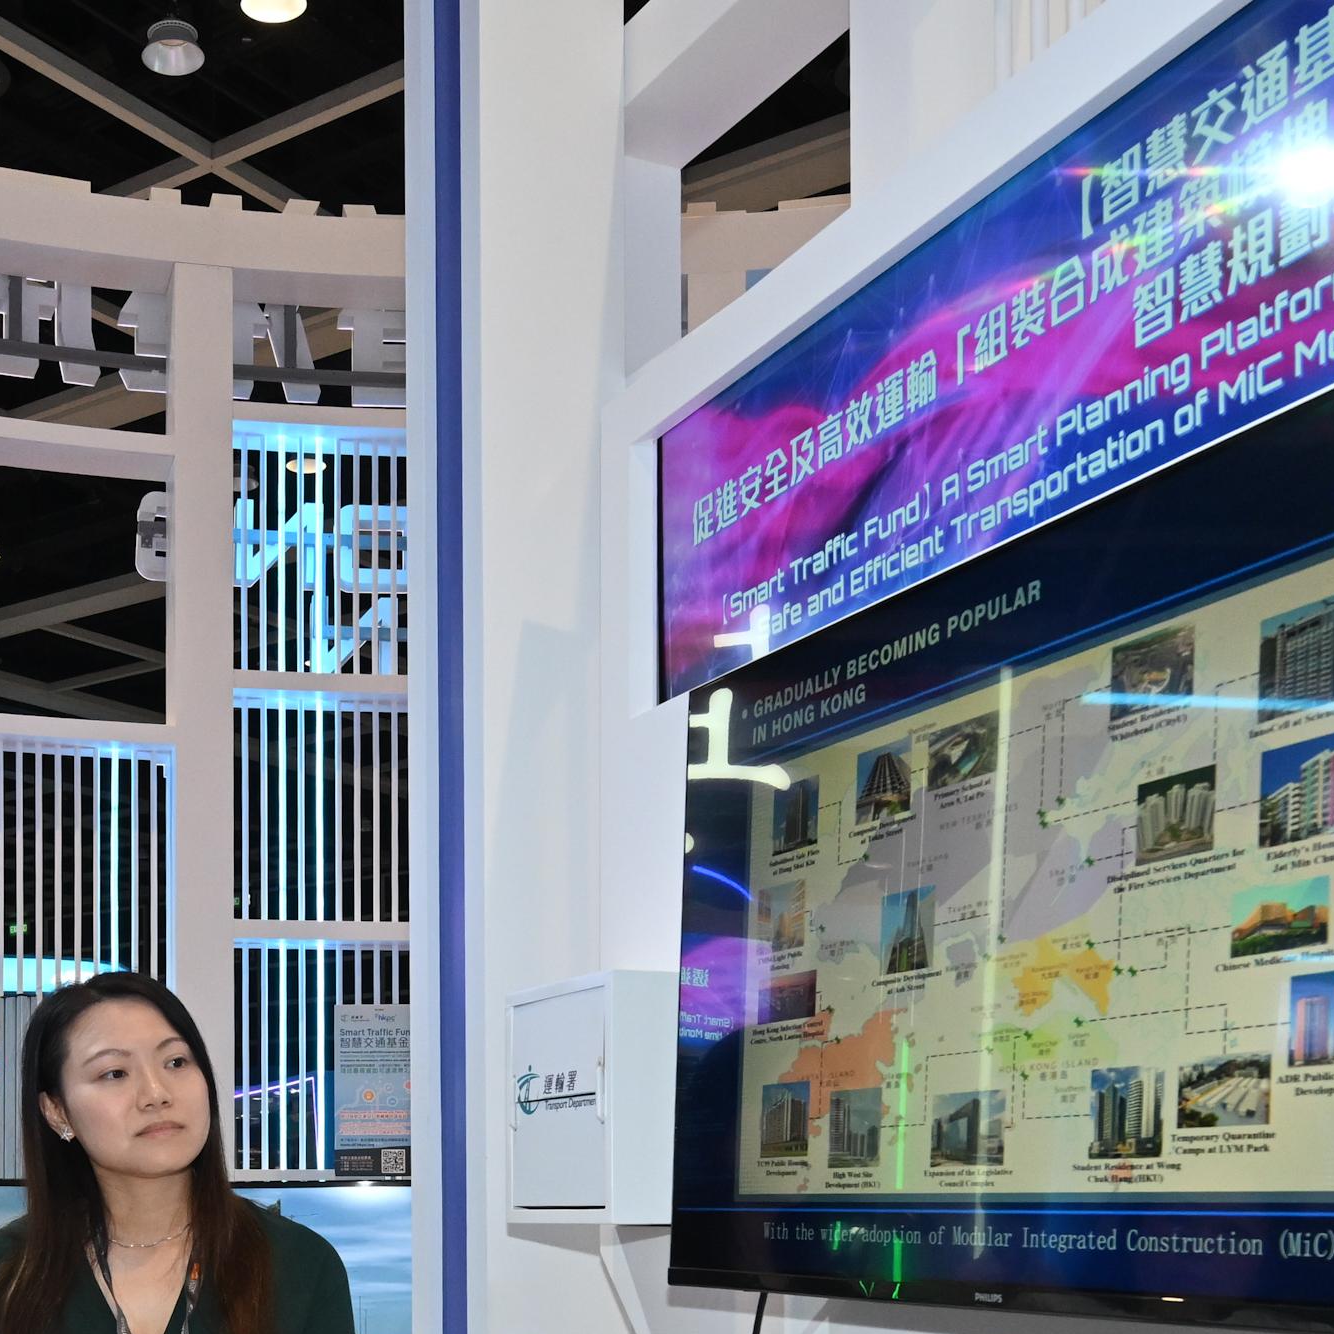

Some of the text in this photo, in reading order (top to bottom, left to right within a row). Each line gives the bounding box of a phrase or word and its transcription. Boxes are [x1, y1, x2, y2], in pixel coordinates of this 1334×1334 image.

[789, 529, 858, 585] Traffic
[942, 474, 960, 506] A
[967, 424, 1048, 493] Smart
[1056, 352, 1192, 447] Planning
[808, 580, 845, 617] and
[850, 528, 944, 597] Efficient
[950, 418, 1165, 546] Transportation
[1173, 386, 1210, 437] of
[1218, 351, 1284, 416] MiC
[753, 579, 1042, 719] GRADUALLY BECOMING POPULAR
[753, 683, 867, 745] IN HONG KONG
[1127, 880, 1145, 893] Fire
[1184, 861, 1238, 882] Department
[1215, 959, 1252, 974] Chinese
[339, 1028, 365, 1037] Smart
[366, 1027, 394, 1037] Traffic
[339, 1036, 410, 1049] 智慧交通基金
[542, 1069, 578, 1096] 運輸署
[545, 1096, 597, 1113] Transport Departmen
[1171, 1128, 1276, 1144] Temporary Quarantine
[1206, 1144, 1217, 1154] at
[1246, 1142, 1270, 1154] Park
[1072, 1161, 1103, 1173] Student
[1104, 1160, 1144, 1172] Residence
[1145, 1161, 1154, 1171] at
[763, 1221, 789, 1241] With
[794, 1221, 815, 1242] the
[861, 1224, 921, 1250] adoption
[928, 1224, 945, 1245] of
[952, 1225, 1013, 1247] Modular
[1022, 1227, 1117, 1253] Integrated
[1126, 1228, 1264, 1257] Construction
[974, 1291, 1003, 1303] PHILIPS
